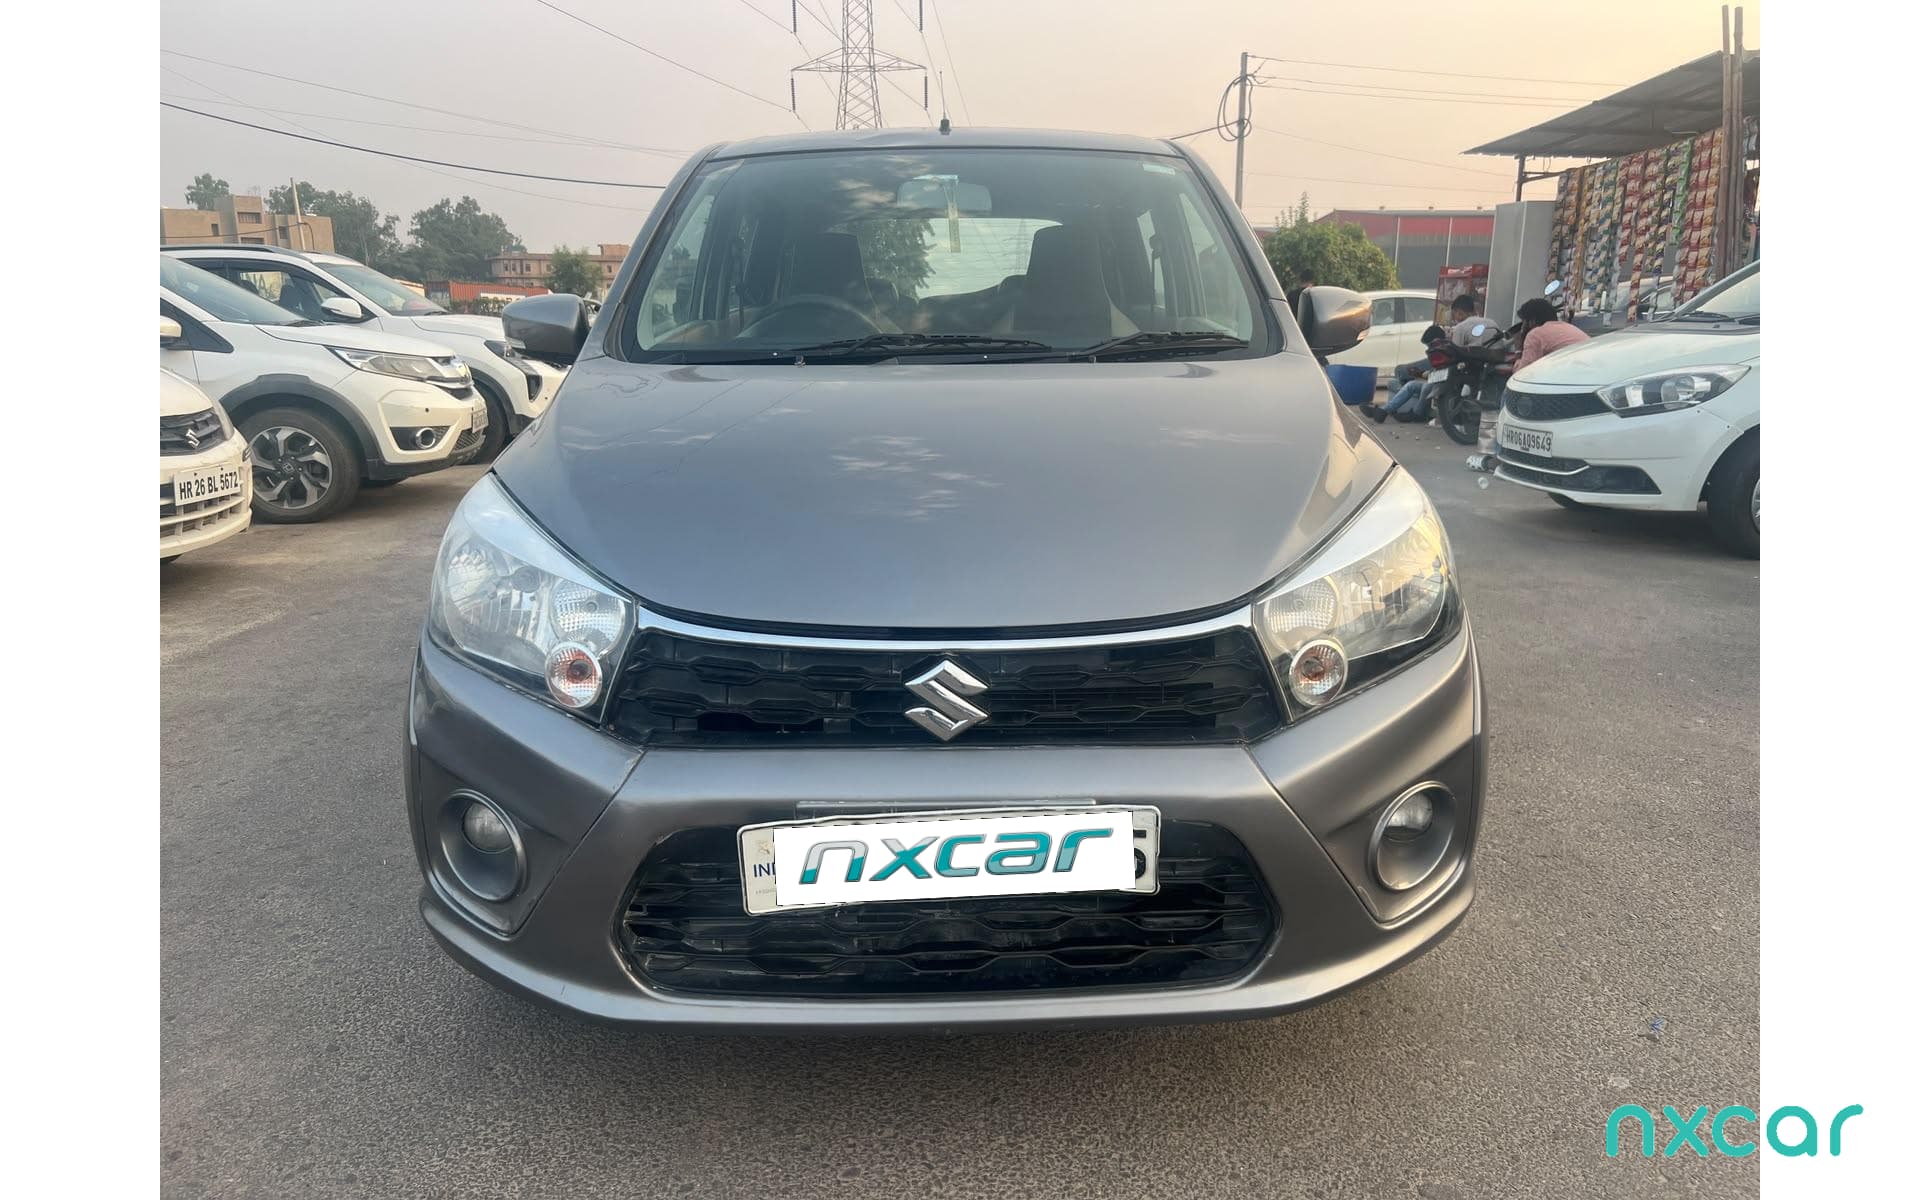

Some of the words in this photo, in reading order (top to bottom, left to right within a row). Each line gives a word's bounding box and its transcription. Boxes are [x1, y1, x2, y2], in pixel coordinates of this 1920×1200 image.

[179, 481, 193, 500] HR
[194, 478, 206, 497] 26
[207, 476, 219, 494] BL
[219, 471, 239, 491] 5672
